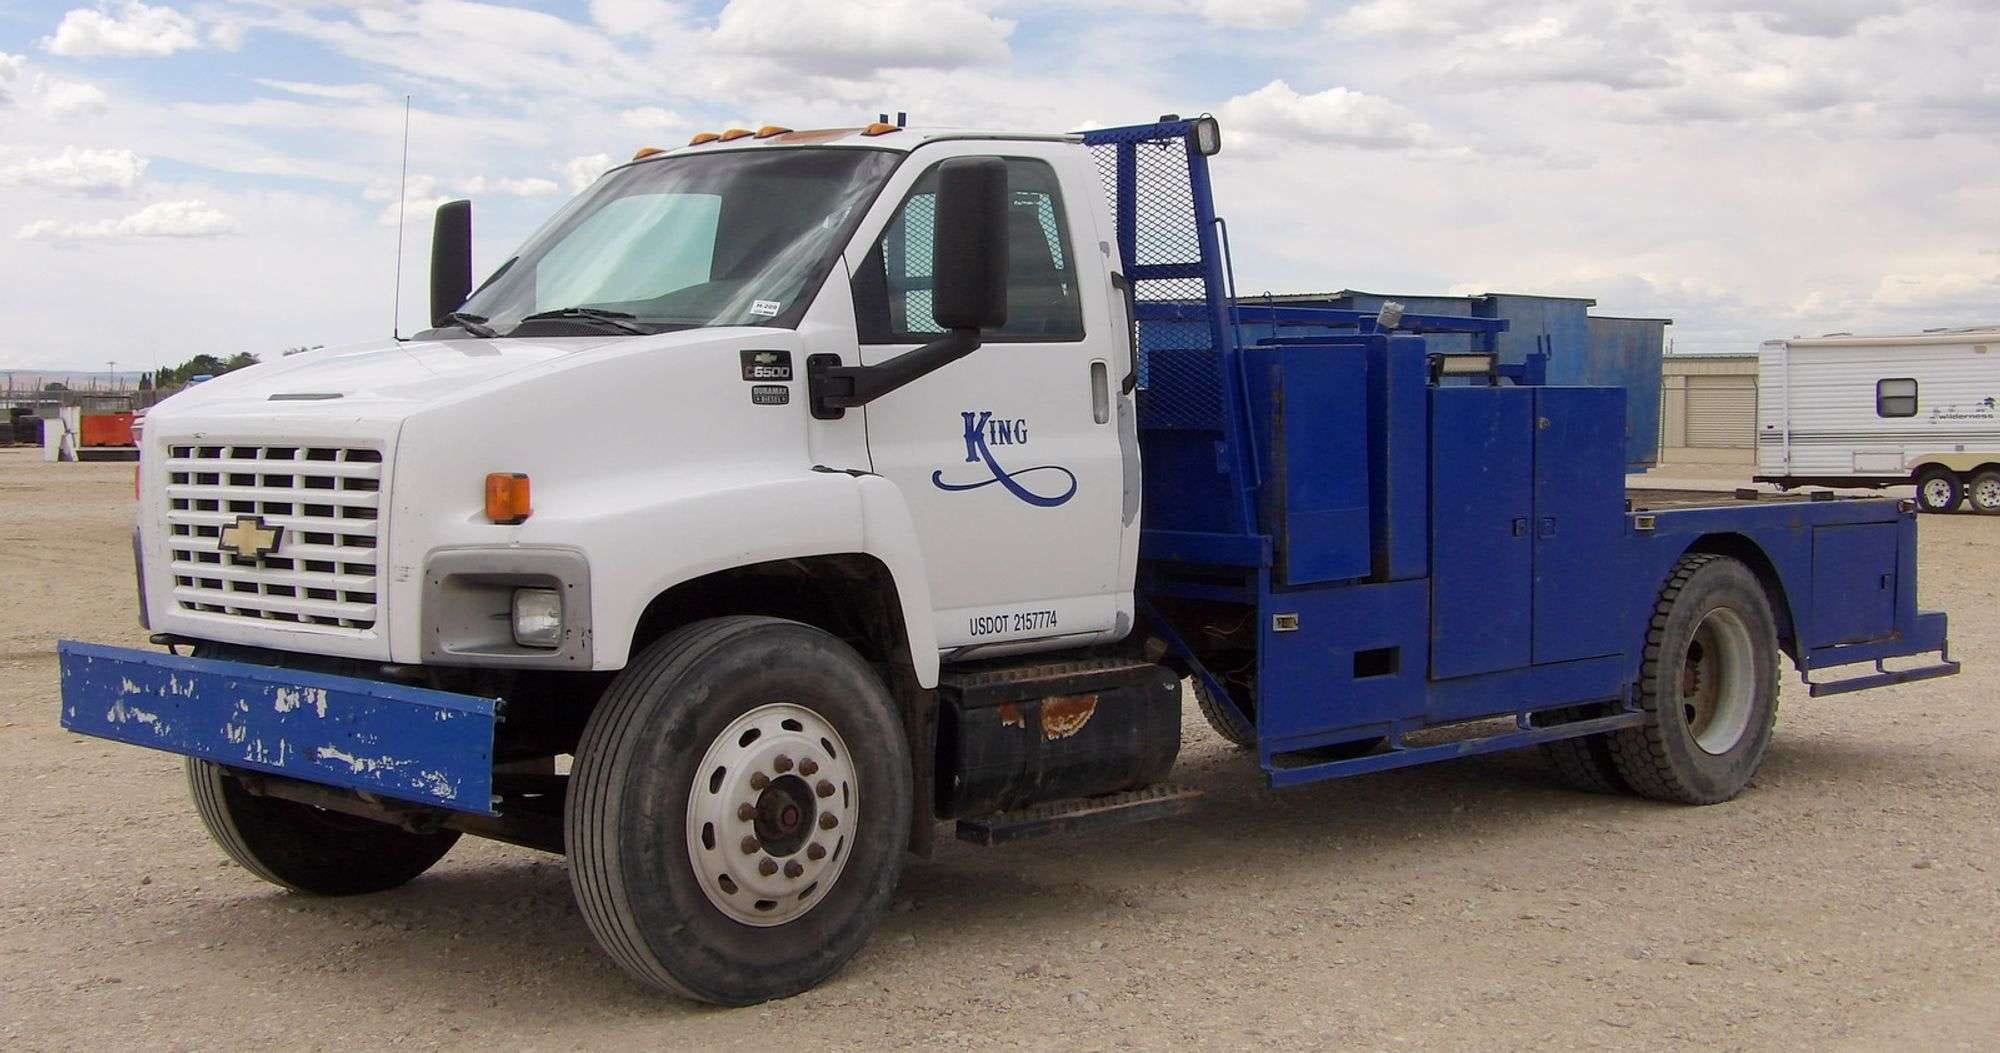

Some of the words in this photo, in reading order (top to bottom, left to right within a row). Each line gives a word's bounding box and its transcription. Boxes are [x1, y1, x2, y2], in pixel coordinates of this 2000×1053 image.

[745, 366, 790, 378] C6500
[753, 387, 787, 395] DURAMAX
[969, 615, 1009, 636] USDOT
[1013, 610, 1058, 632] 2157774
